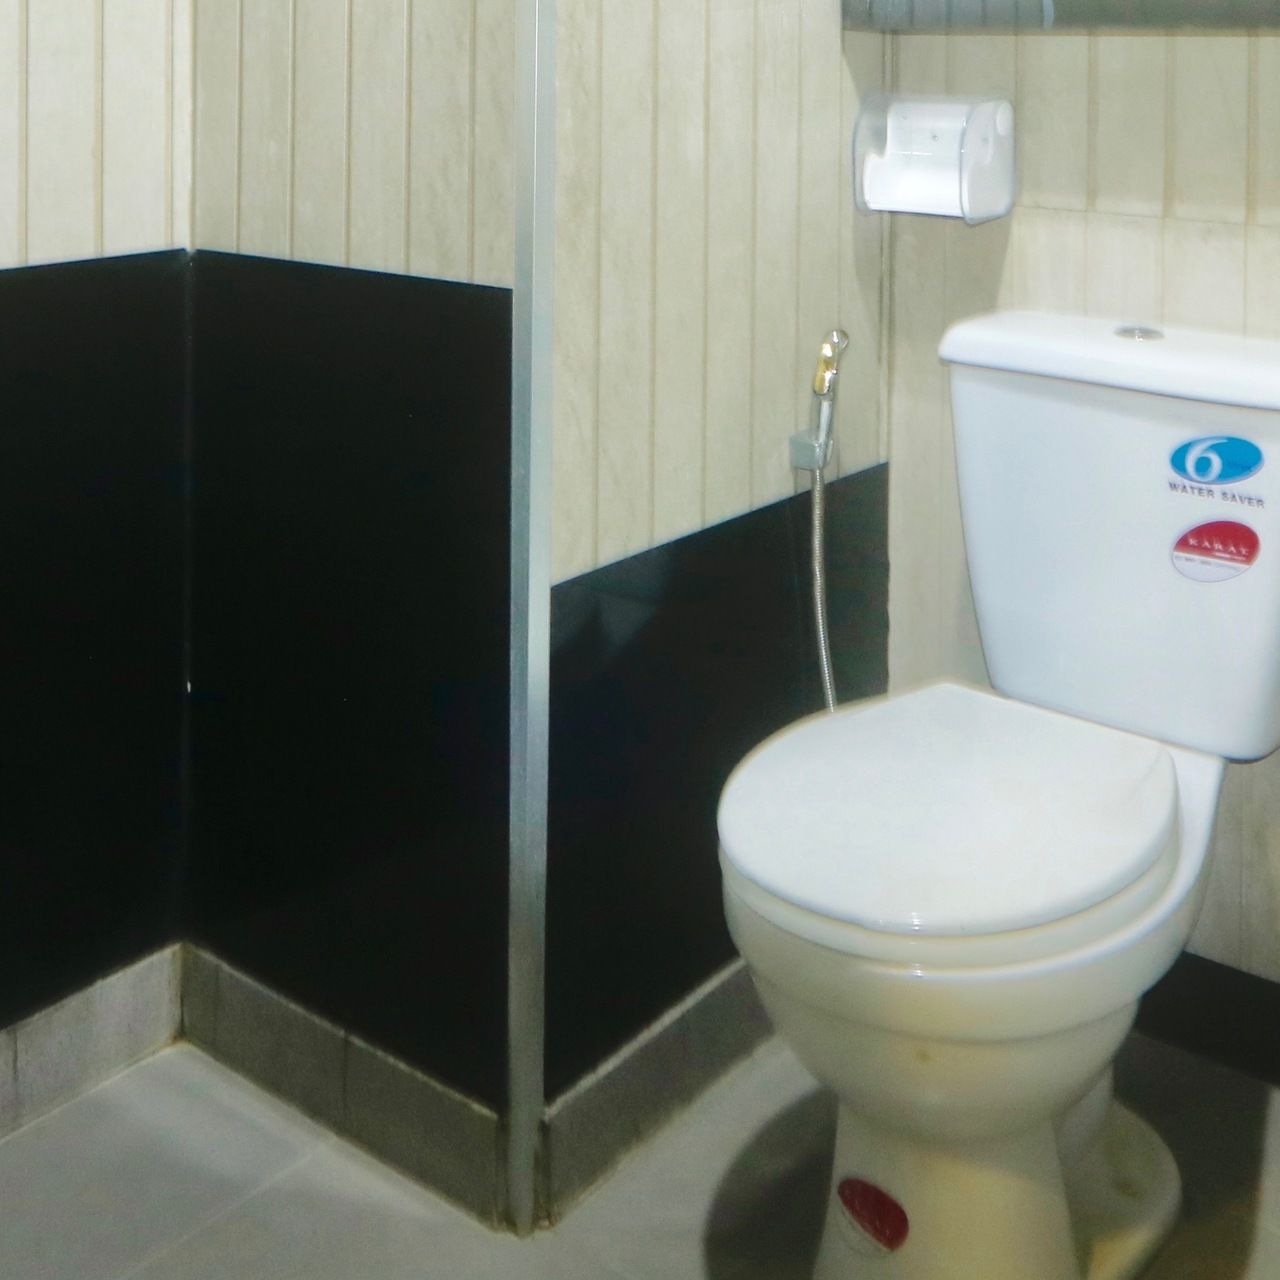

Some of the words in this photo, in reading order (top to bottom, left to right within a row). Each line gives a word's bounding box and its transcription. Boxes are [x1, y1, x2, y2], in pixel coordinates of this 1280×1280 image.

[1185, 438, 1228, 481] 6
[1169, 482, 1215, 499] WATER
[1221, 491, 1264, 508] SAVER
[1187, 537, 1249, 555] KARAT
